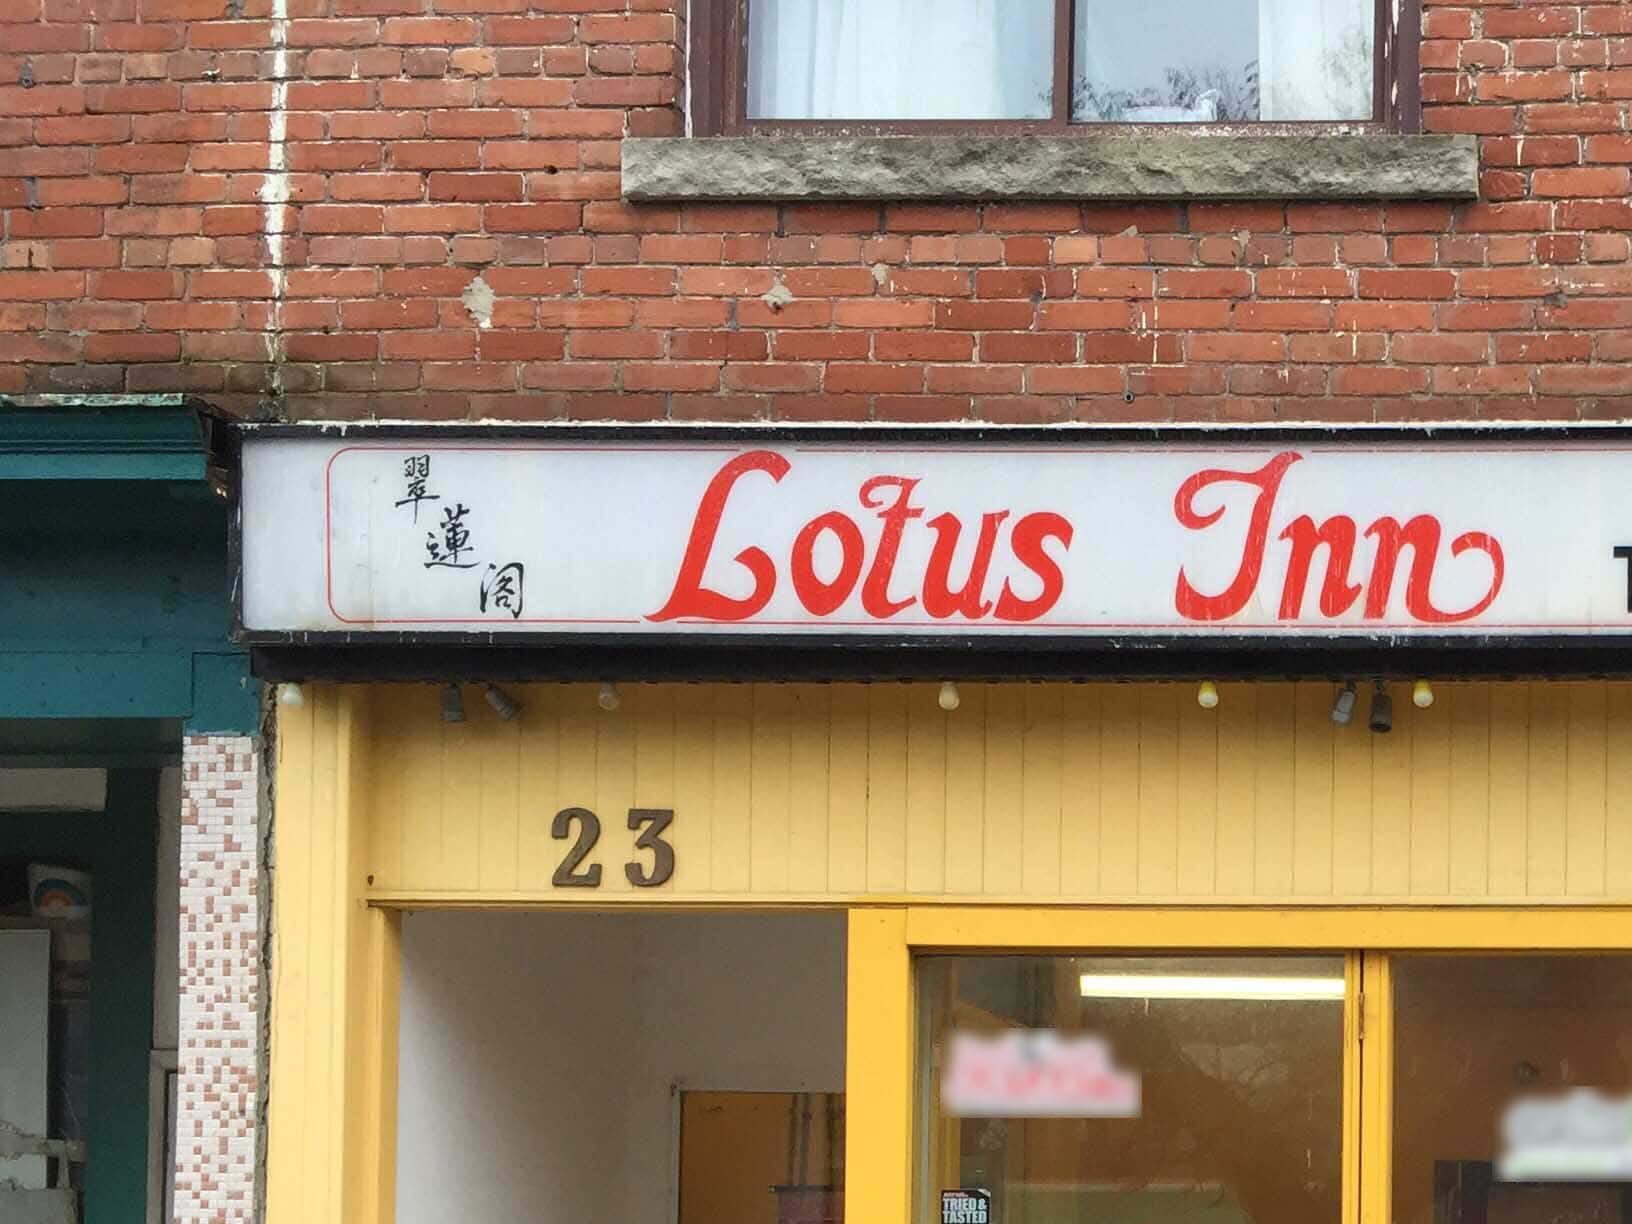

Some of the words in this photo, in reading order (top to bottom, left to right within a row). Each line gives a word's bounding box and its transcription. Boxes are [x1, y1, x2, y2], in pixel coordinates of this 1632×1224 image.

[643, 450, 1074, 623] Lotus
[1174, 451, 1506, 623] Inn
[550, 807, 676, 888] 23
[942, 1210, 987, 1224] TASTED
[943, 1198, 977, 1210] TRIED
